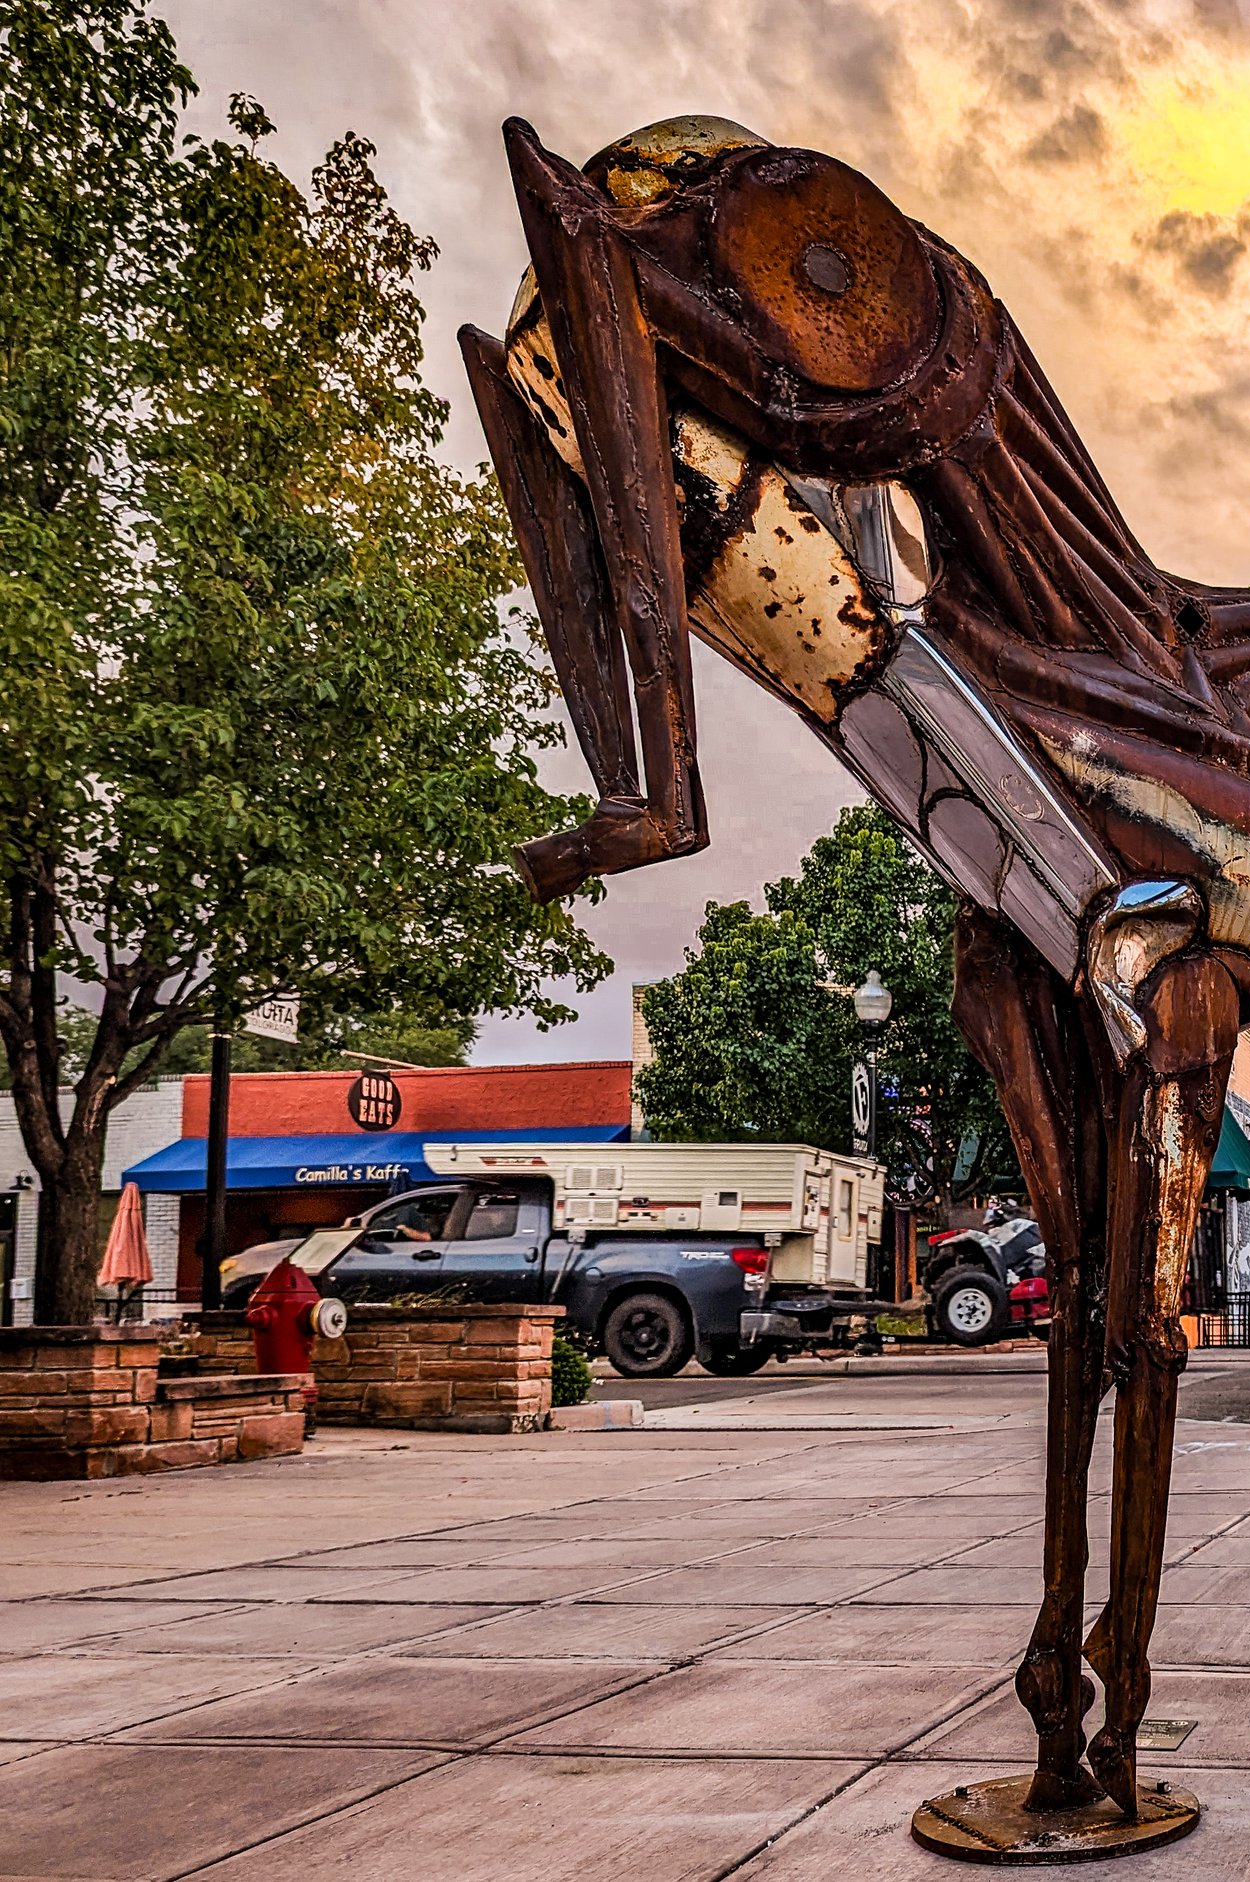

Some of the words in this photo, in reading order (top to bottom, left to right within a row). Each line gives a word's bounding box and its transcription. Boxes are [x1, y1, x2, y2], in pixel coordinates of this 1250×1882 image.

[361, 1076, 393, 1101] GOOD
[359, 1098, 394, 1126] EATS
[295, 1164, 363, 1182] Camilla's
